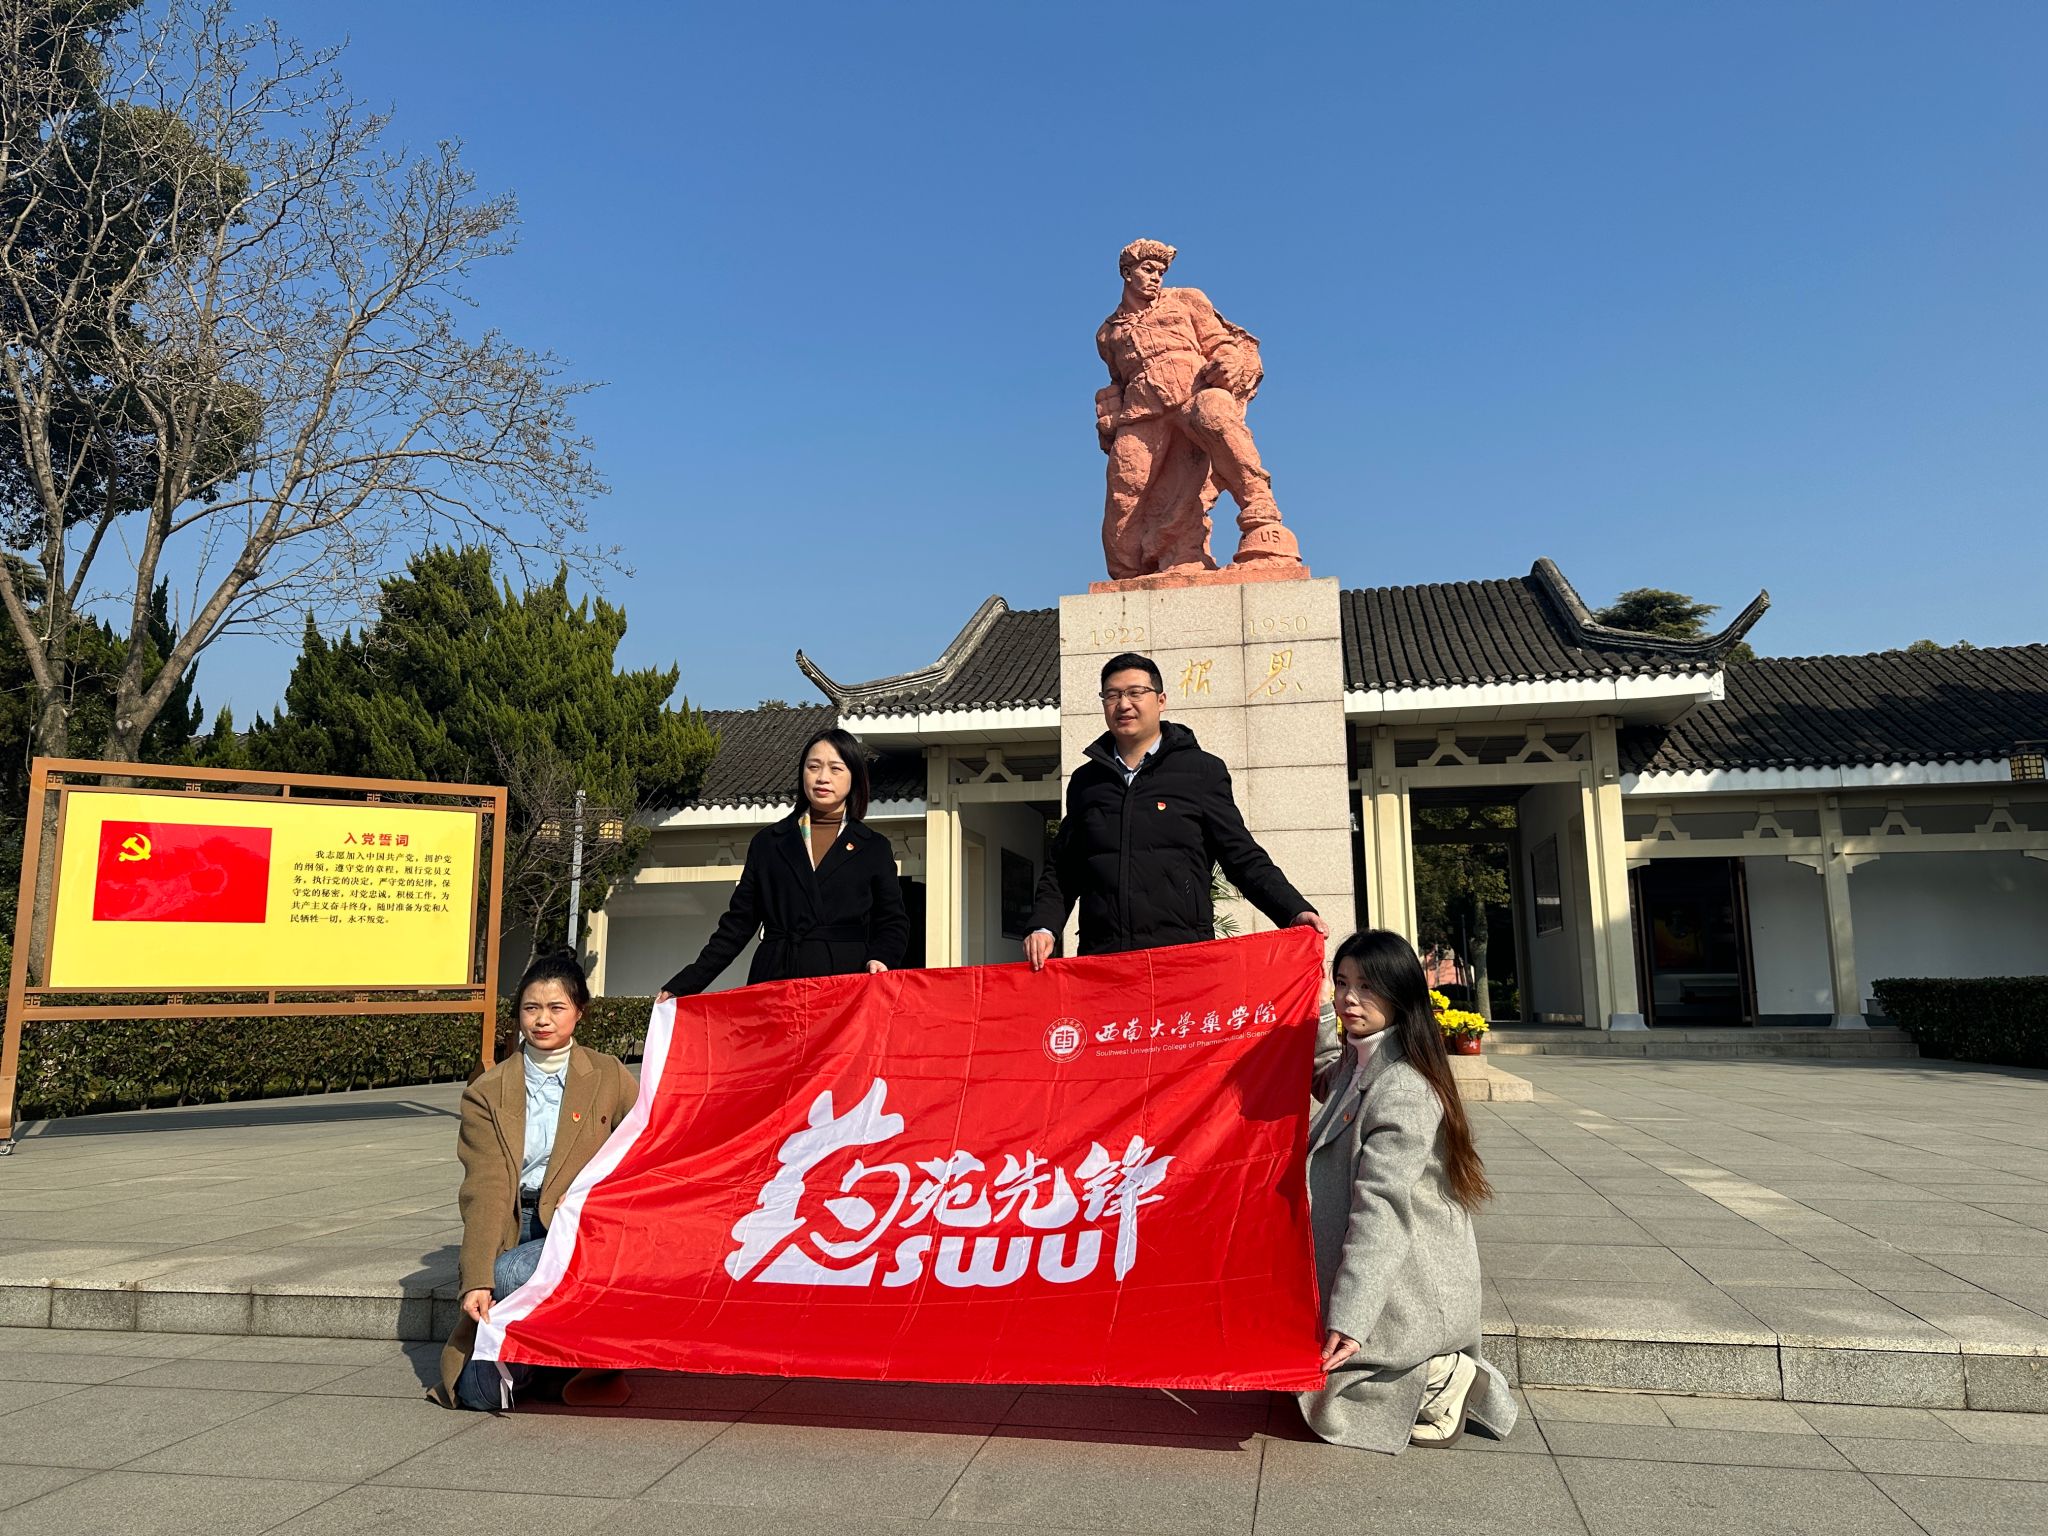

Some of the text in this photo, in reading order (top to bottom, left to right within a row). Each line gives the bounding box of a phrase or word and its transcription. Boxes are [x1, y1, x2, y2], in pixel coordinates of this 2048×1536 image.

[1261, 530, 1280, 543] US
[1090, 626, 1145, 646] 1922
[1250, 615, 1308, 636] 1950
[344, 832, 409, 847] 入党誓词
[1095, 1048, 1129, 1057] Southwest
[1130, 1045, 1161, 1055] University
[1162, 1042, 1187, 1051] College
[1188, 1040, 1196, 1049] of
[724, 1077, 1176, 1288] 药苑先锋
